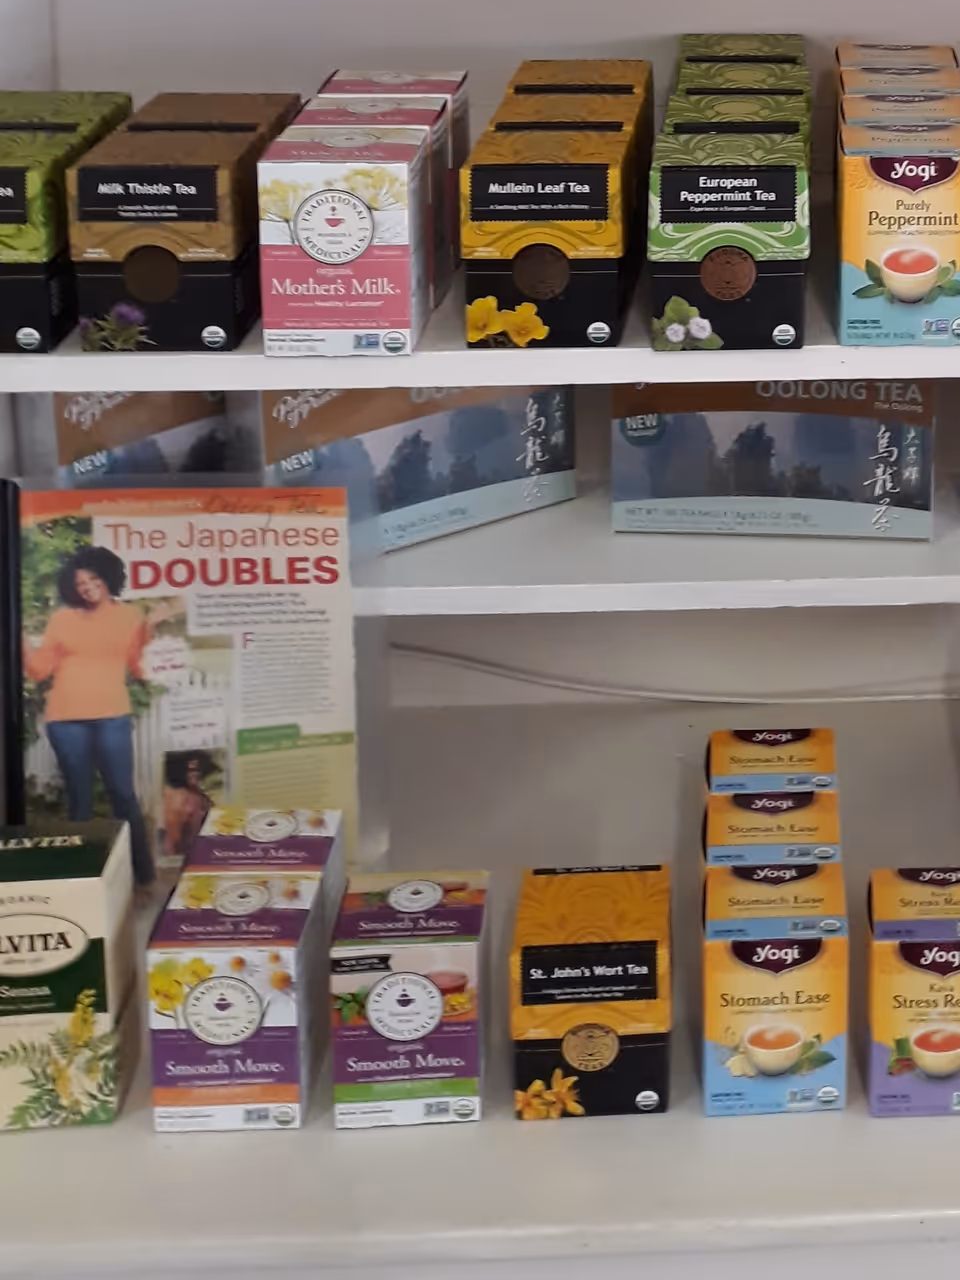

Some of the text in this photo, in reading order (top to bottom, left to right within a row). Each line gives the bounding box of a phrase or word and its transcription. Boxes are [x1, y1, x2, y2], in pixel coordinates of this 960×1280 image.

[97, 183, 196, 195] Milk Thistle Tea
[488, 183, 590, 194] Mullein Leaf Tea
[699, 176, 757, 188] European
[680, 190, 776, 204] Peppermint Tea
[895, 200, 931, 212] Purely
[868, 211, 959, 230] Peppermint
[271, 278, 395, 295] Mother's Milk
[755, 381, 923, 402] OOLONG TEA
[625, 413, 658, 430] NEW
[73, 450, 108, 474] NEW
[280, 449, 314, 471] NEW
[104, 522, 339, 553] The Japanese
[130, 556, 340, 590] DOUBLES
[530, 964, 648, 979] St. John's Wort Tea
[720, 991, 830, 1007] Stomach Ease
[892, 995, 939, 1009] Stress
[166, 1060, 281, 1075] Smooth Move
[346, 1054, 460, 1072] Smooth Move
